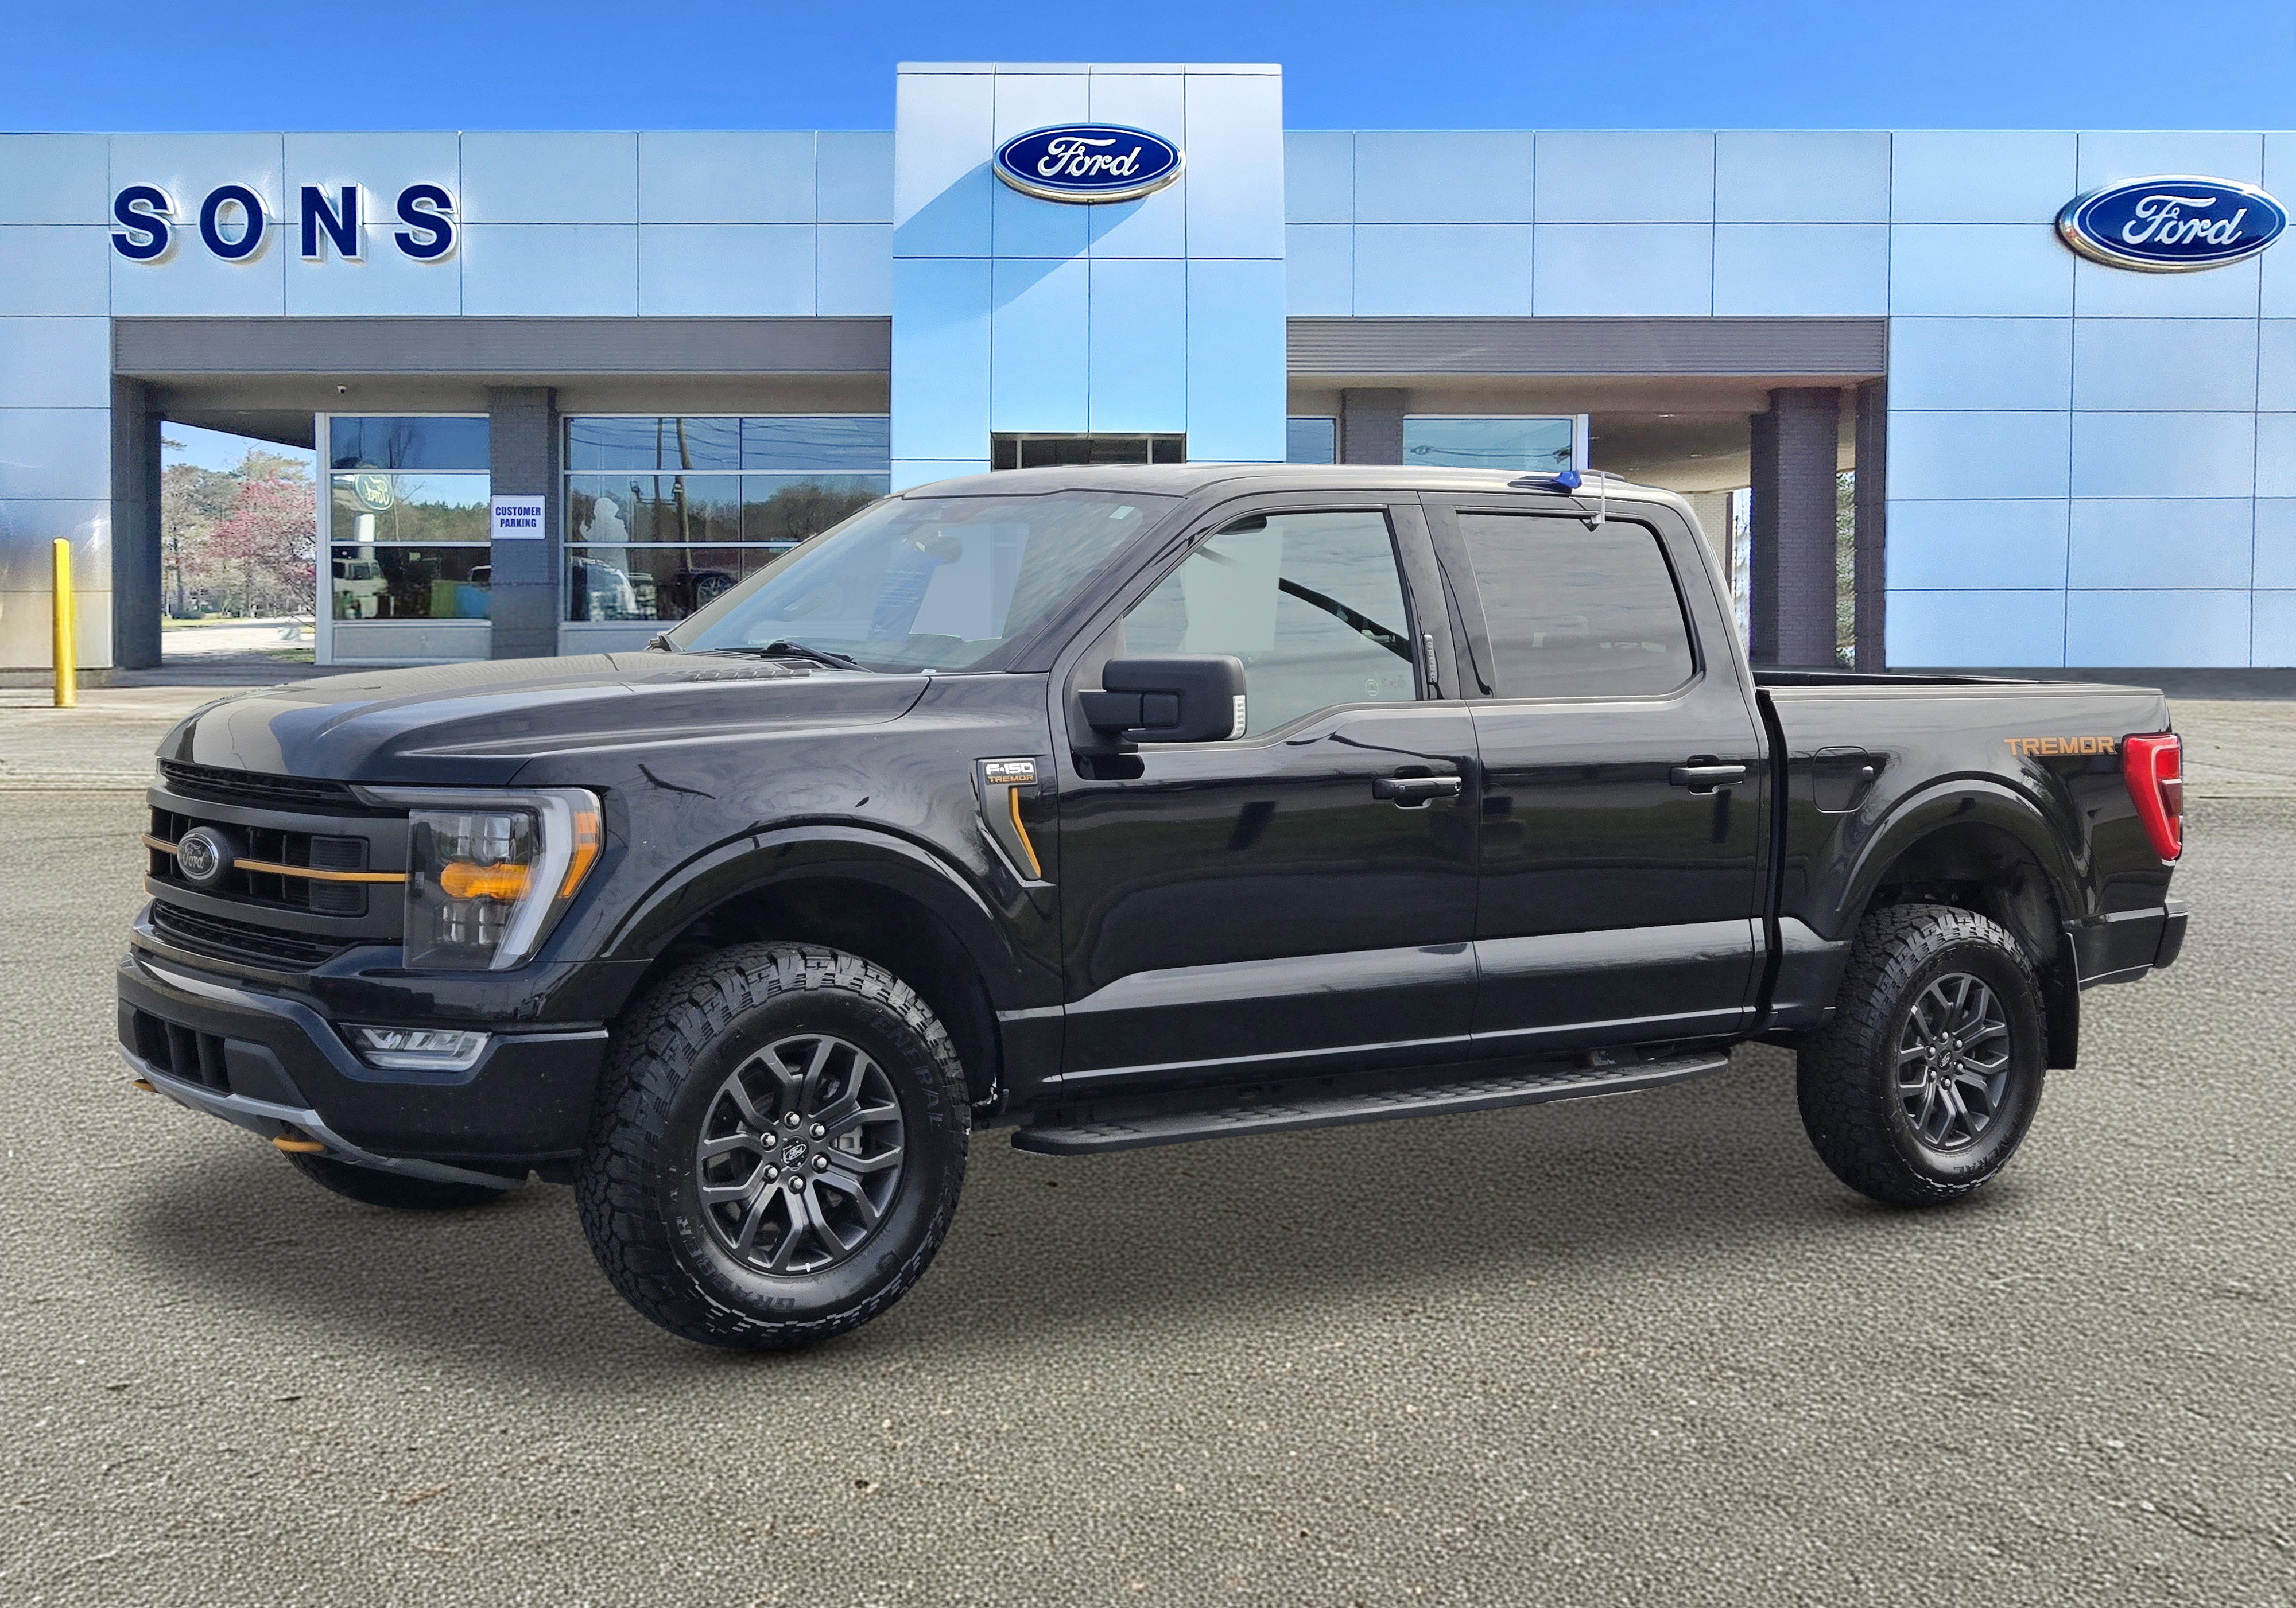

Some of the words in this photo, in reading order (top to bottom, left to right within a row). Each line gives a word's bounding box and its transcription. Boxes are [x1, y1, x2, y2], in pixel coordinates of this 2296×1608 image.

[1037, 137, 1142, 177] Ford
[111, 183, 457, 261] SONS
[2122, 195, 2248, 245] Ford
[495, 506, 541, 516] CUSTOMER
[500, 518, 537, 527] PARKING
[2003, 736, 2116, 756] TREMOR
[986, 762, 1034, 775] F-150
[987, 774, 1034, 783] TREMOR
[183, 842, 207, 869] Ford
[856, 1004, 943, 1132] GENERAL
[675, 1216, 796, 1312] GRABBER
